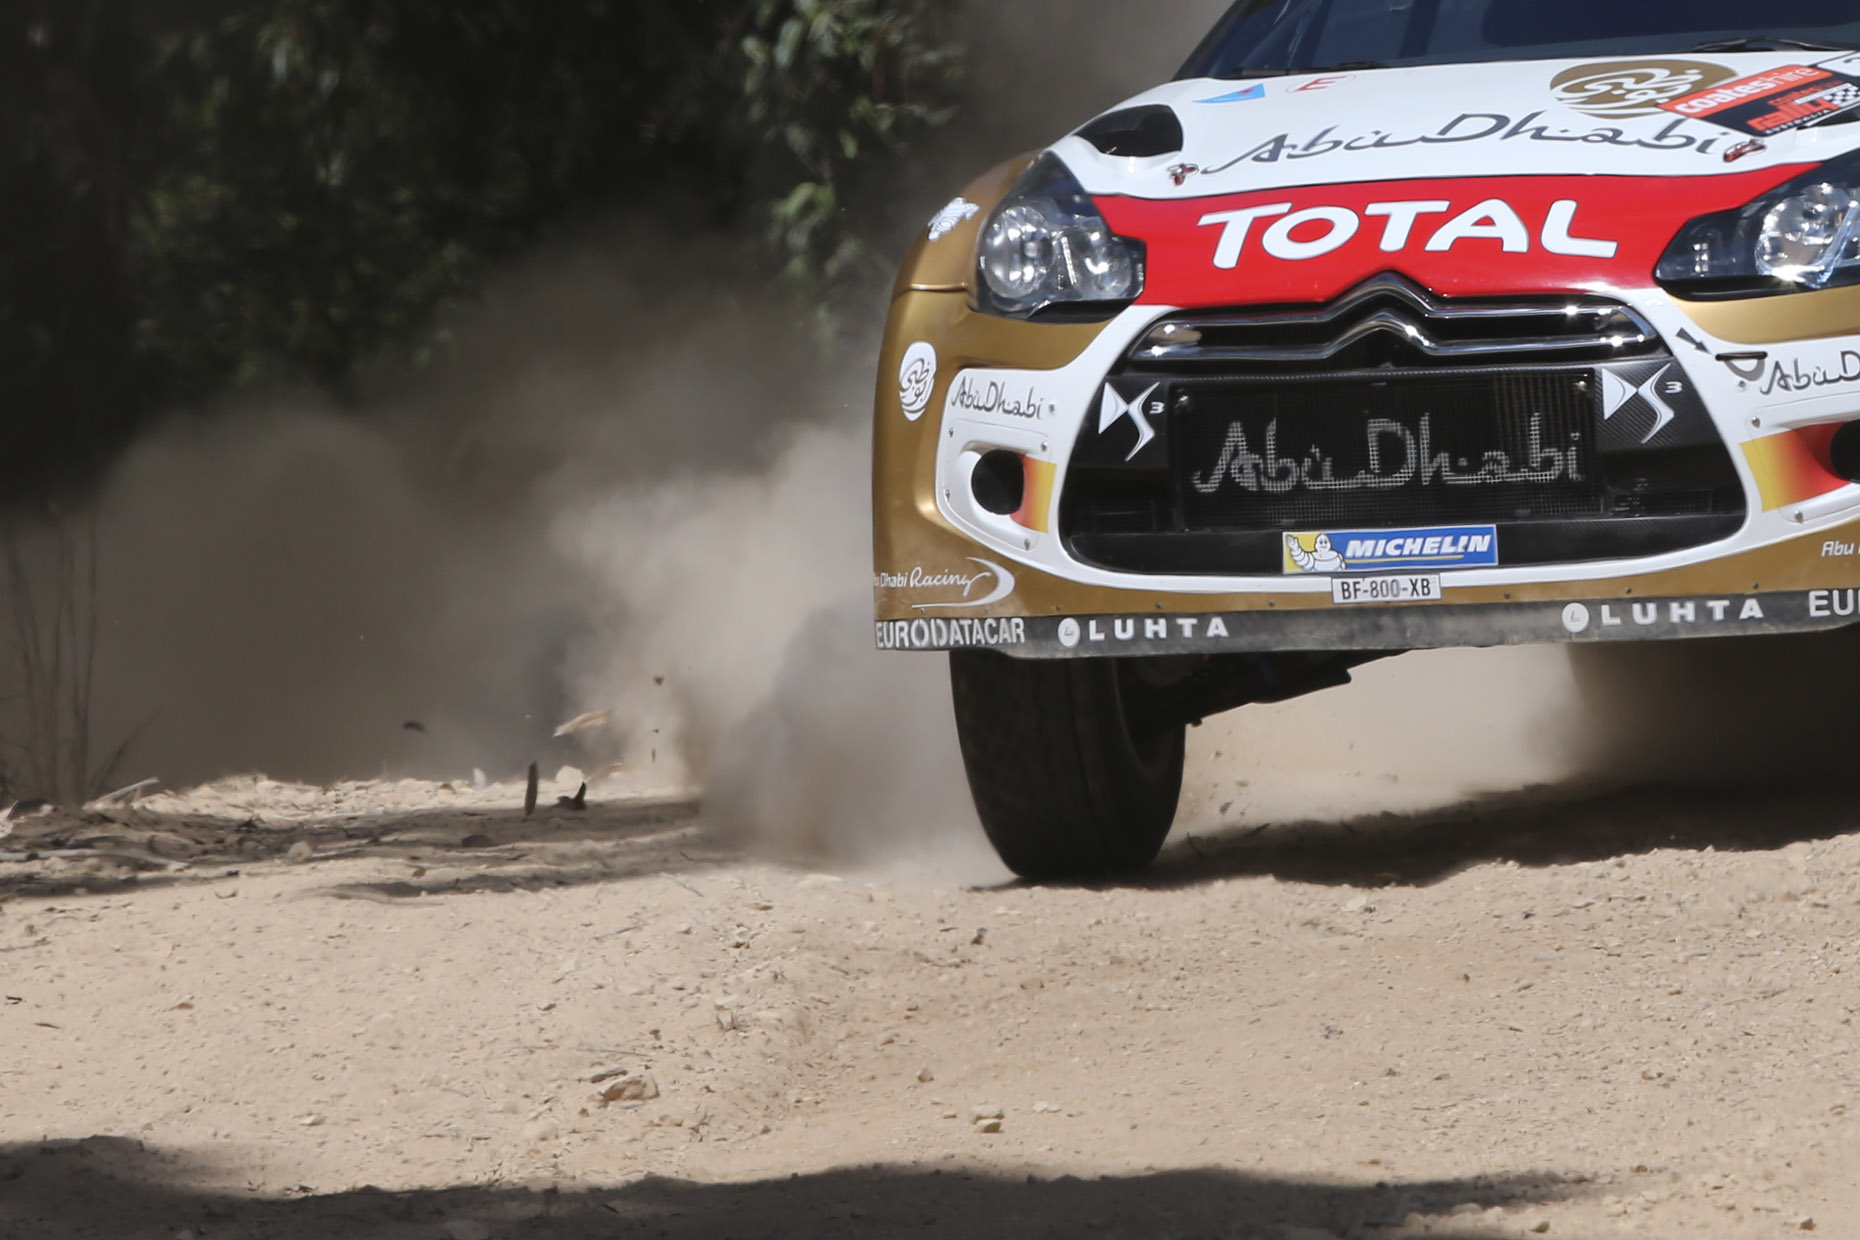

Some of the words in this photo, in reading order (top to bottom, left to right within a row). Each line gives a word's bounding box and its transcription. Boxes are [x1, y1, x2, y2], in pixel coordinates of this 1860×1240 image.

[1197, 198, 1618, 269] TOTAL
[1345, 534, 1492, 560] MICHELIN
[1821, 538, 1855, 558] Abu
[1341, 579, 1432, 600] BF-800-XB
[1601, 598, 1764, 625] LUHTA
[876, 617, 1026, 649] EURODATACAR
[1089, 615, 1229, 642] LUHTA
